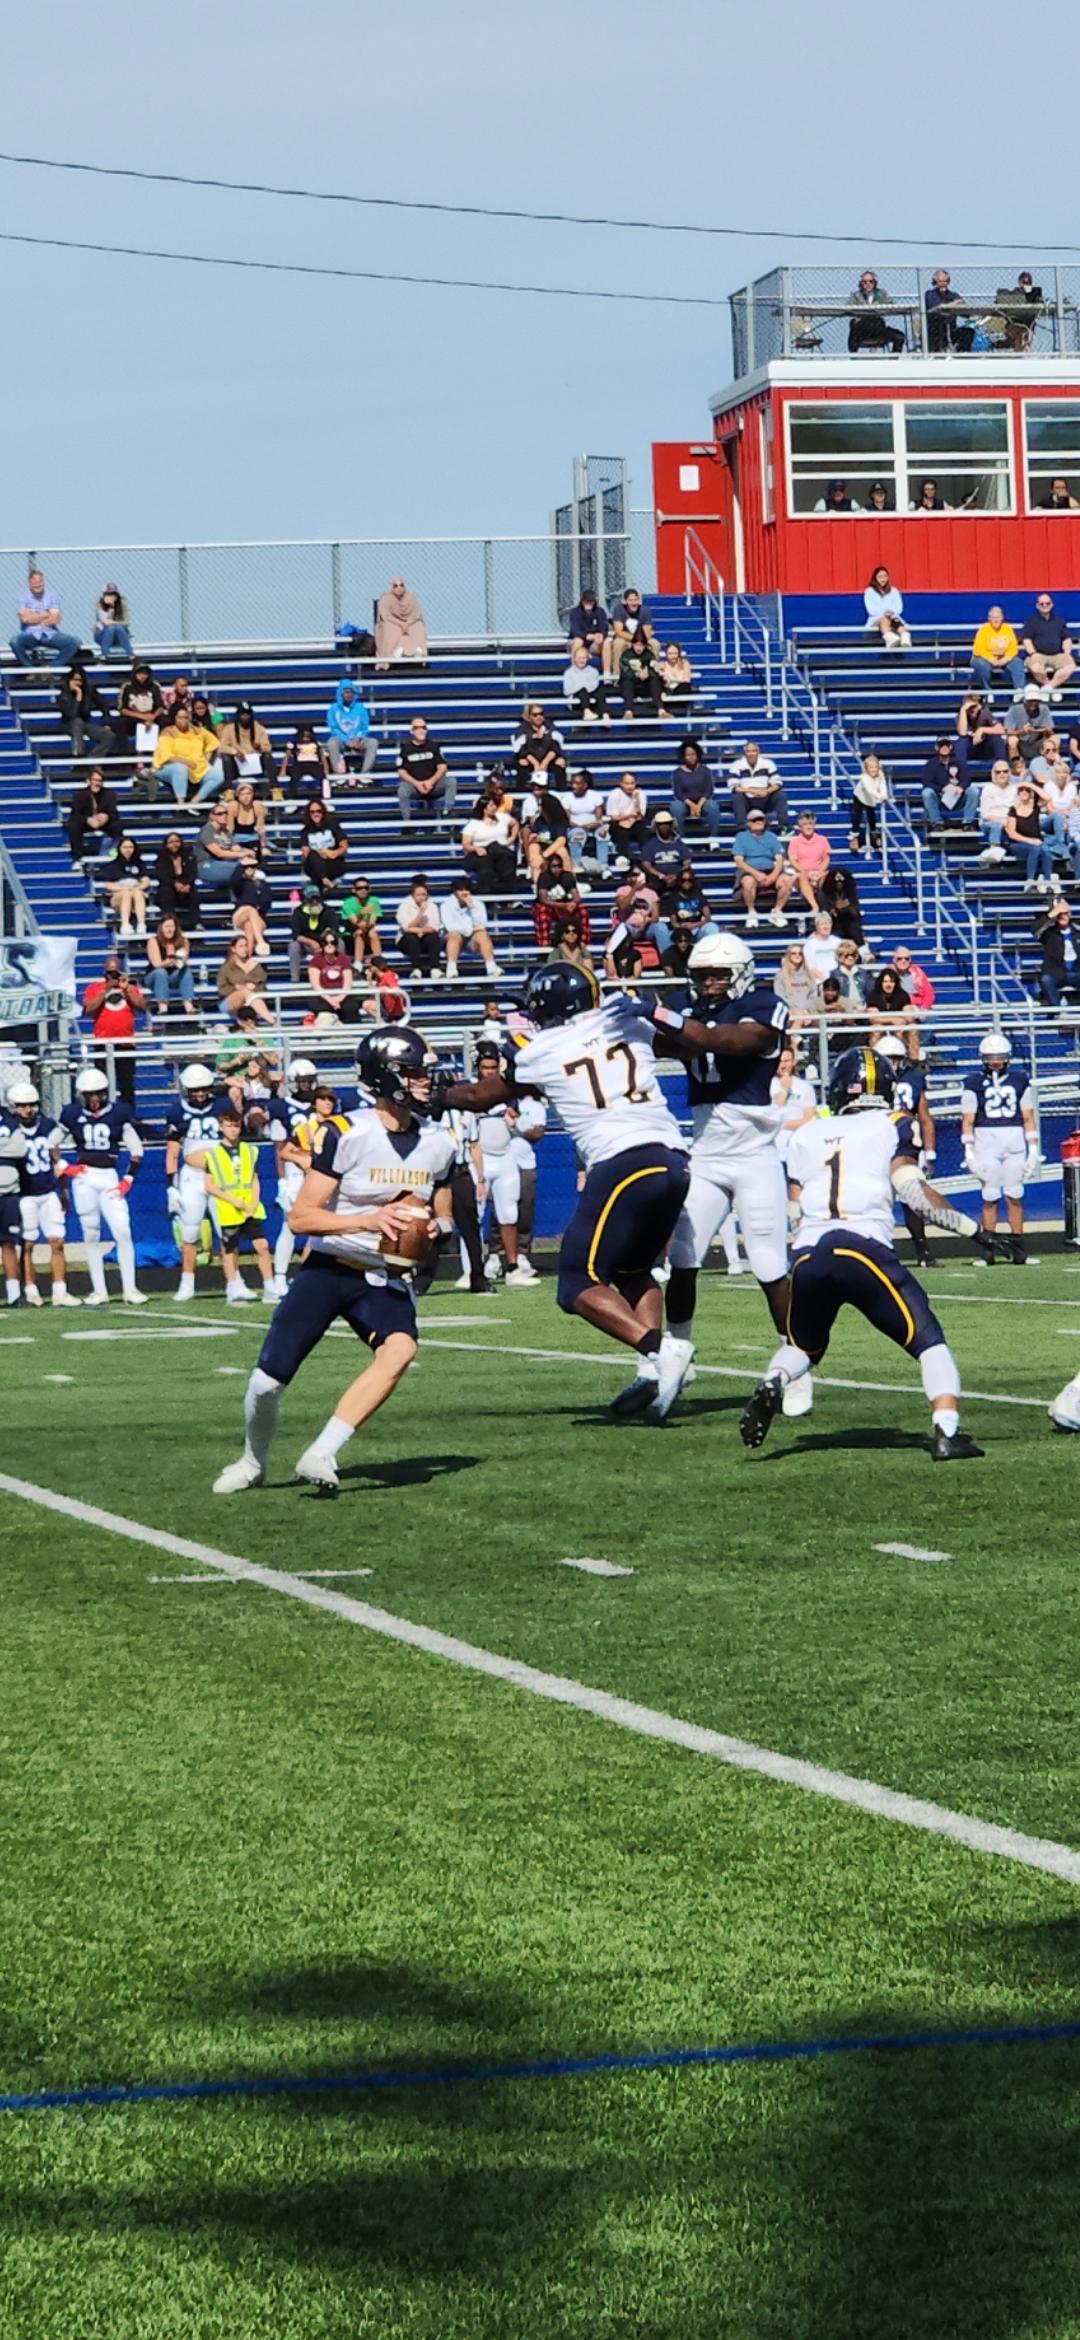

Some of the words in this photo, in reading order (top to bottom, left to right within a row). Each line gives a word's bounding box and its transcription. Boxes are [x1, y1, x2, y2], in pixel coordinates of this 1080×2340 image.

[0, 990, 72, 1019] TBALL
[562, 1040, 652, 1110] 72
[984, 1085, 1017, 1118] 23
[24, 1136, 52, 1175] 33
[824, 1147, 847, 1220] 1
